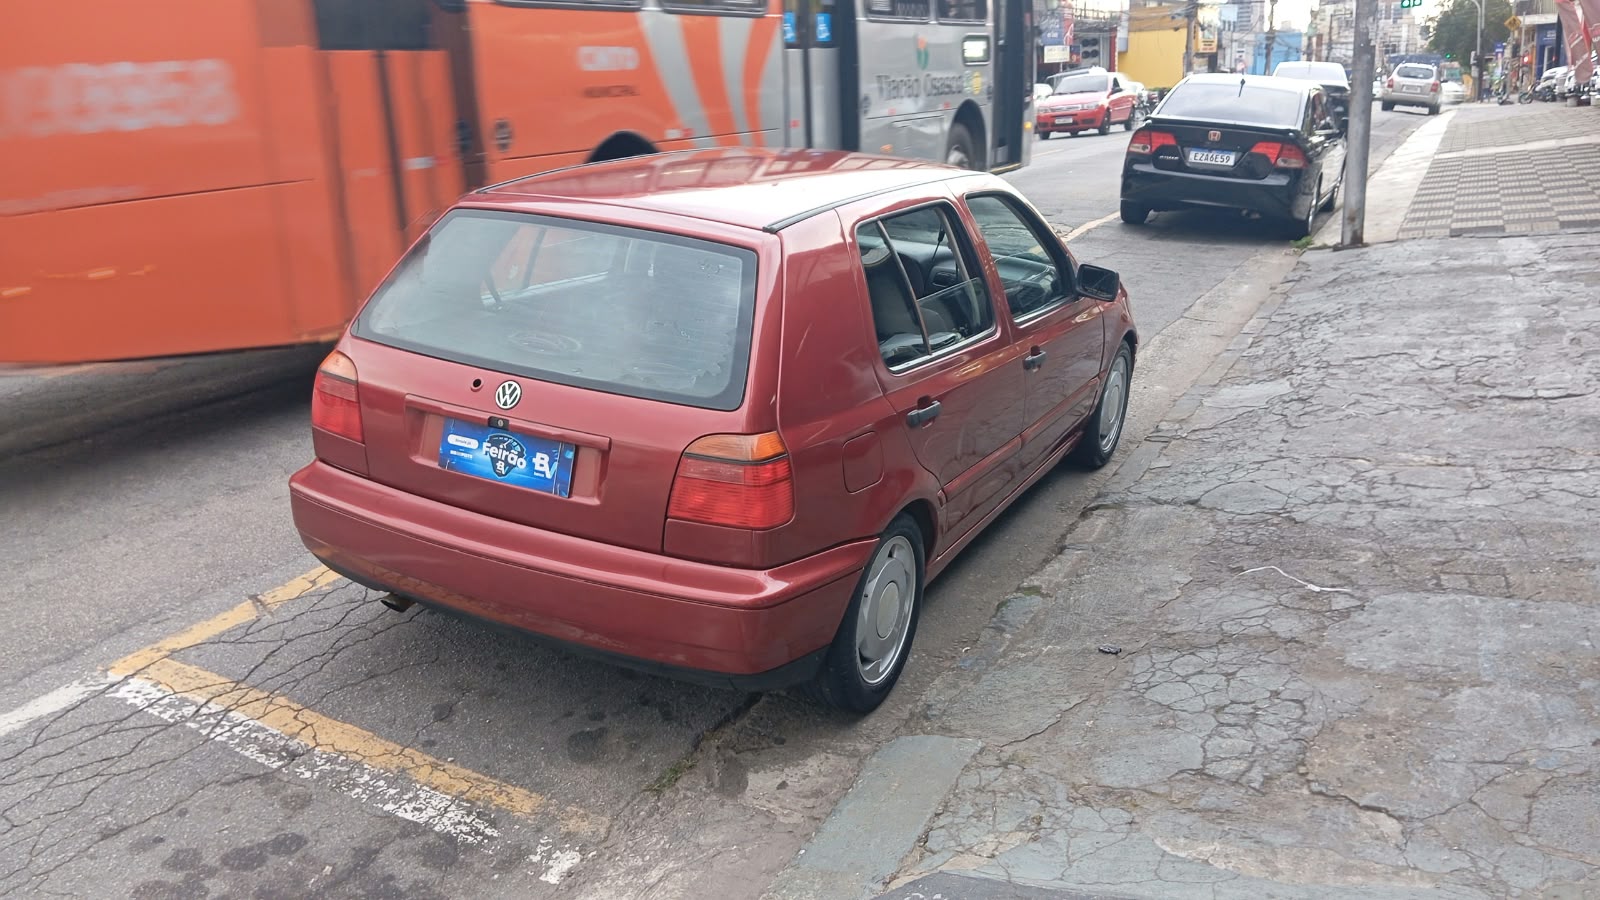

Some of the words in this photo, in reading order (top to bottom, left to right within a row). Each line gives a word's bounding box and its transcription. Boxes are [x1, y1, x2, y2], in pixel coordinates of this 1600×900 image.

[924, 73, 963, 97] Osasco
[1193, 152, 1231, 164] EZA6E59
[482, 442, 527, 469] Feirão
